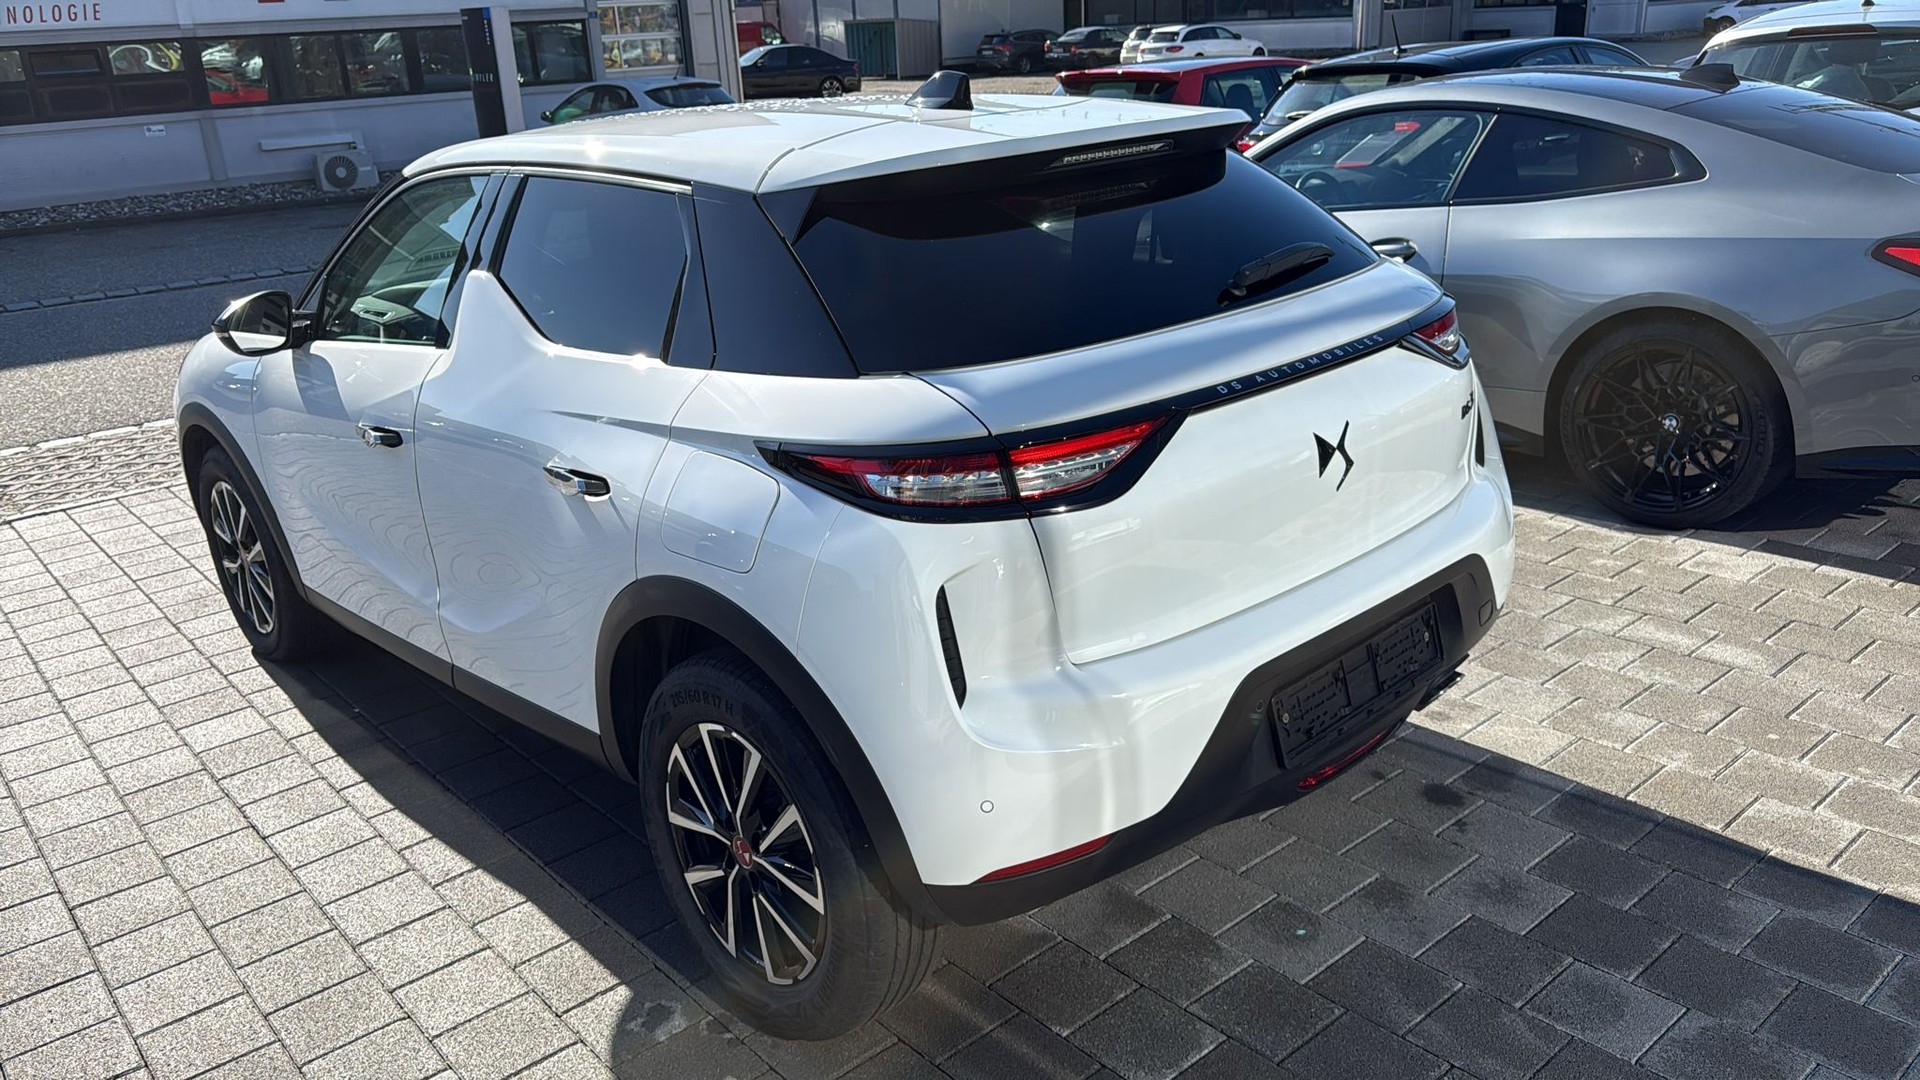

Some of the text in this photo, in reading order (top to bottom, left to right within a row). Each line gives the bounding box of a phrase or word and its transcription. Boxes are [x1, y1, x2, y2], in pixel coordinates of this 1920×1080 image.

[6, 3, 101, 24] NOLOGIE
[1216, 334, 1384, 394] DS AUTOMOBILES
[670, 688, 701, 708] 215/60
[725, 699, 734, 717] H
